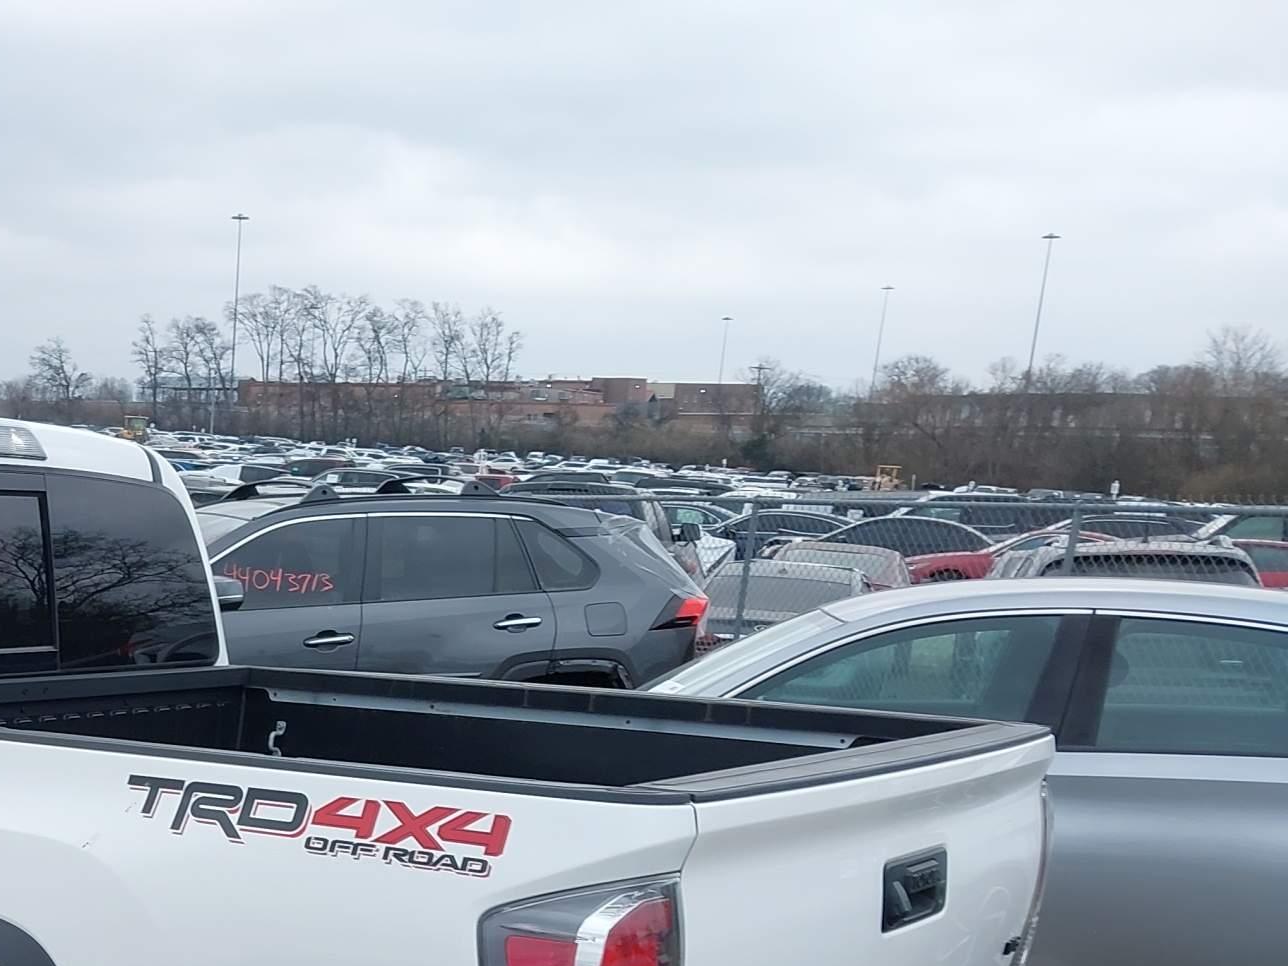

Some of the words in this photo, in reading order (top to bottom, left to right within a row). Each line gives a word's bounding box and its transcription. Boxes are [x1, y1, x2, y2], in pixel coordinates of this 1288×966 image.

[223, 562, 335, 594] 44043713
[127, 774, 312, 845] TRD
[304, 835, 380, 859] OFF
[381, 846, 492, 878] ROAD
